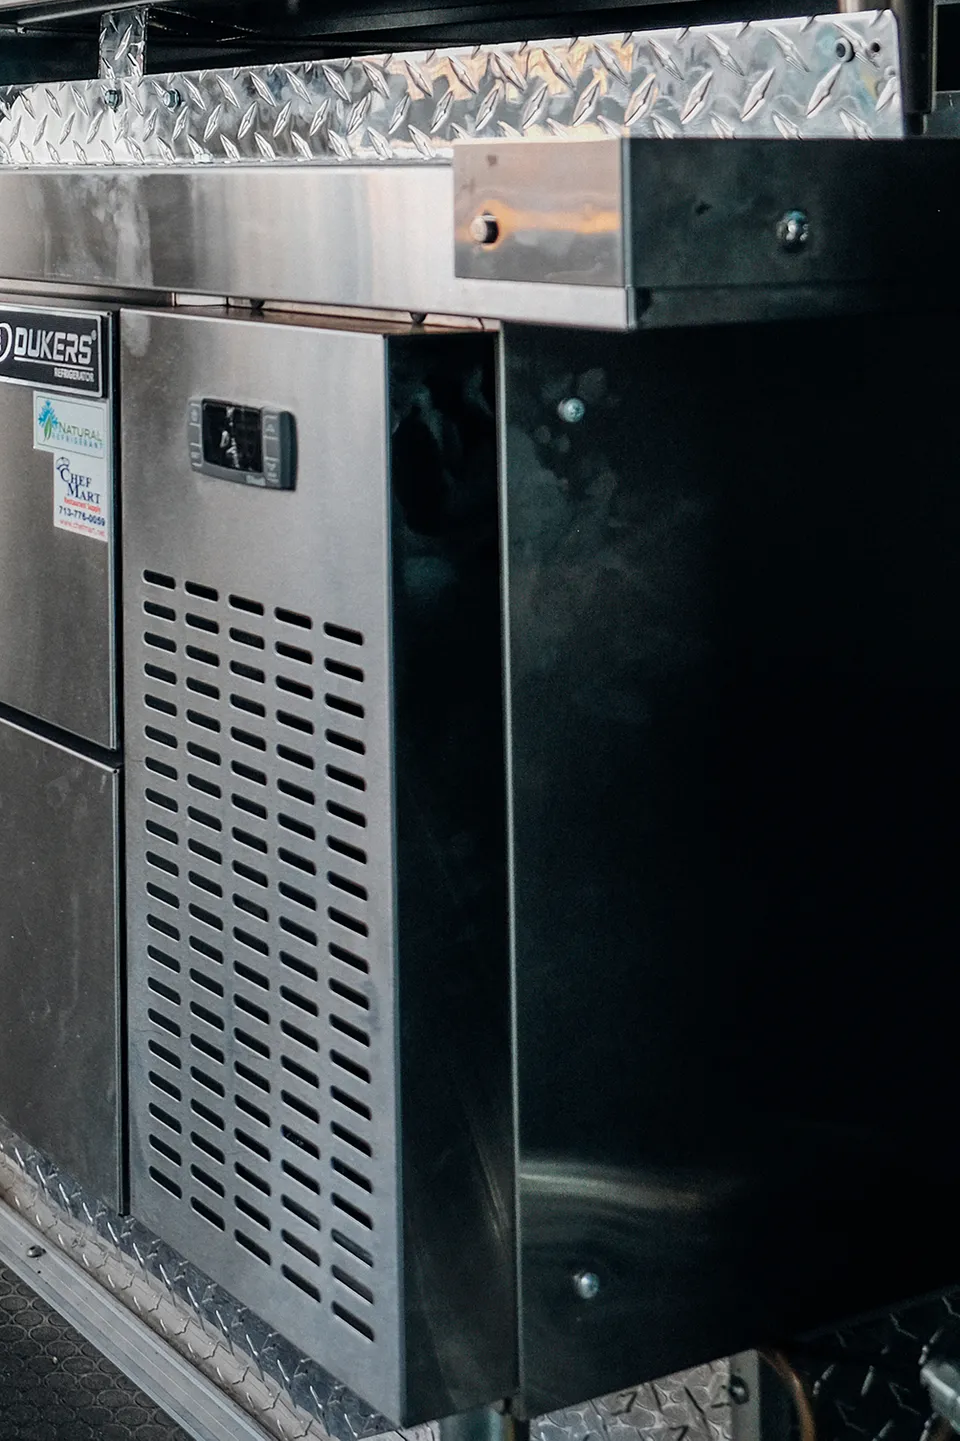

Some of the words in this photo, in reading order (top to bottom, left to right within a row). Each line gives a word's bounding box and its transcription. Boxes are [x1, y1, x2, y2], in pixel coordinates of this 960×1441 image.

[14, 326, 92, 365] DUKERS
[53, 366, 95, 383] REFRIGERATOR
[58, 421, 102, 442] NATURAL
[60, 467, 92, 488] CHEF
[66, 482, 101, 505] MART
